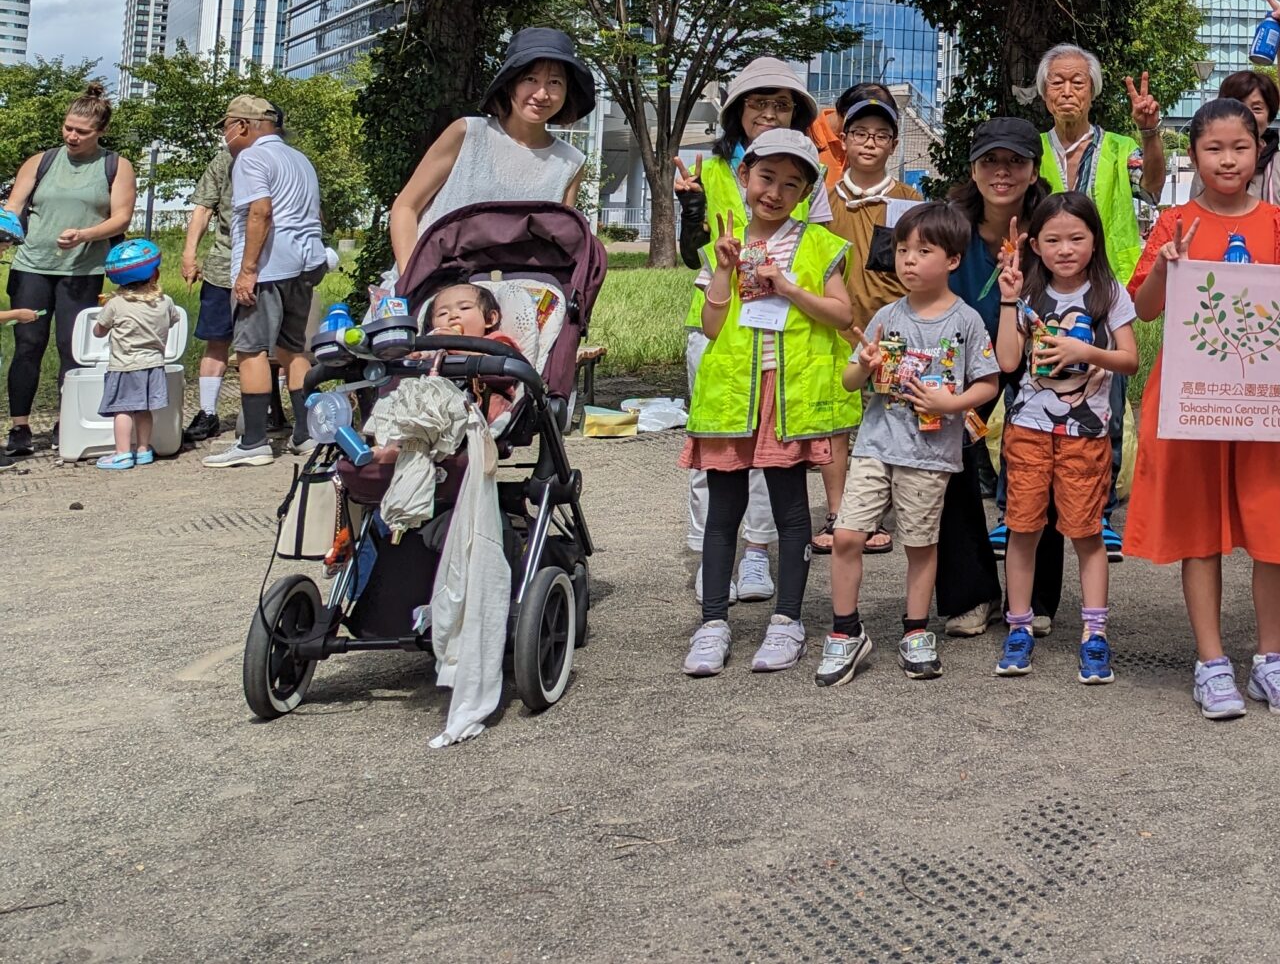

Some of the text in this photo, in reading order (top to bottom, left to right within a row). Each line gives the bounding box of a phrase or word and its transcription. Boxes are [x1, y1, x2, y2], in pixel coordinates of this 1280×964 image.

[1179, 402, 1232, 414] Takashima
[1235, 404, 1269, 415] Central
[1179, 415, 1254, 427] GARDENING
